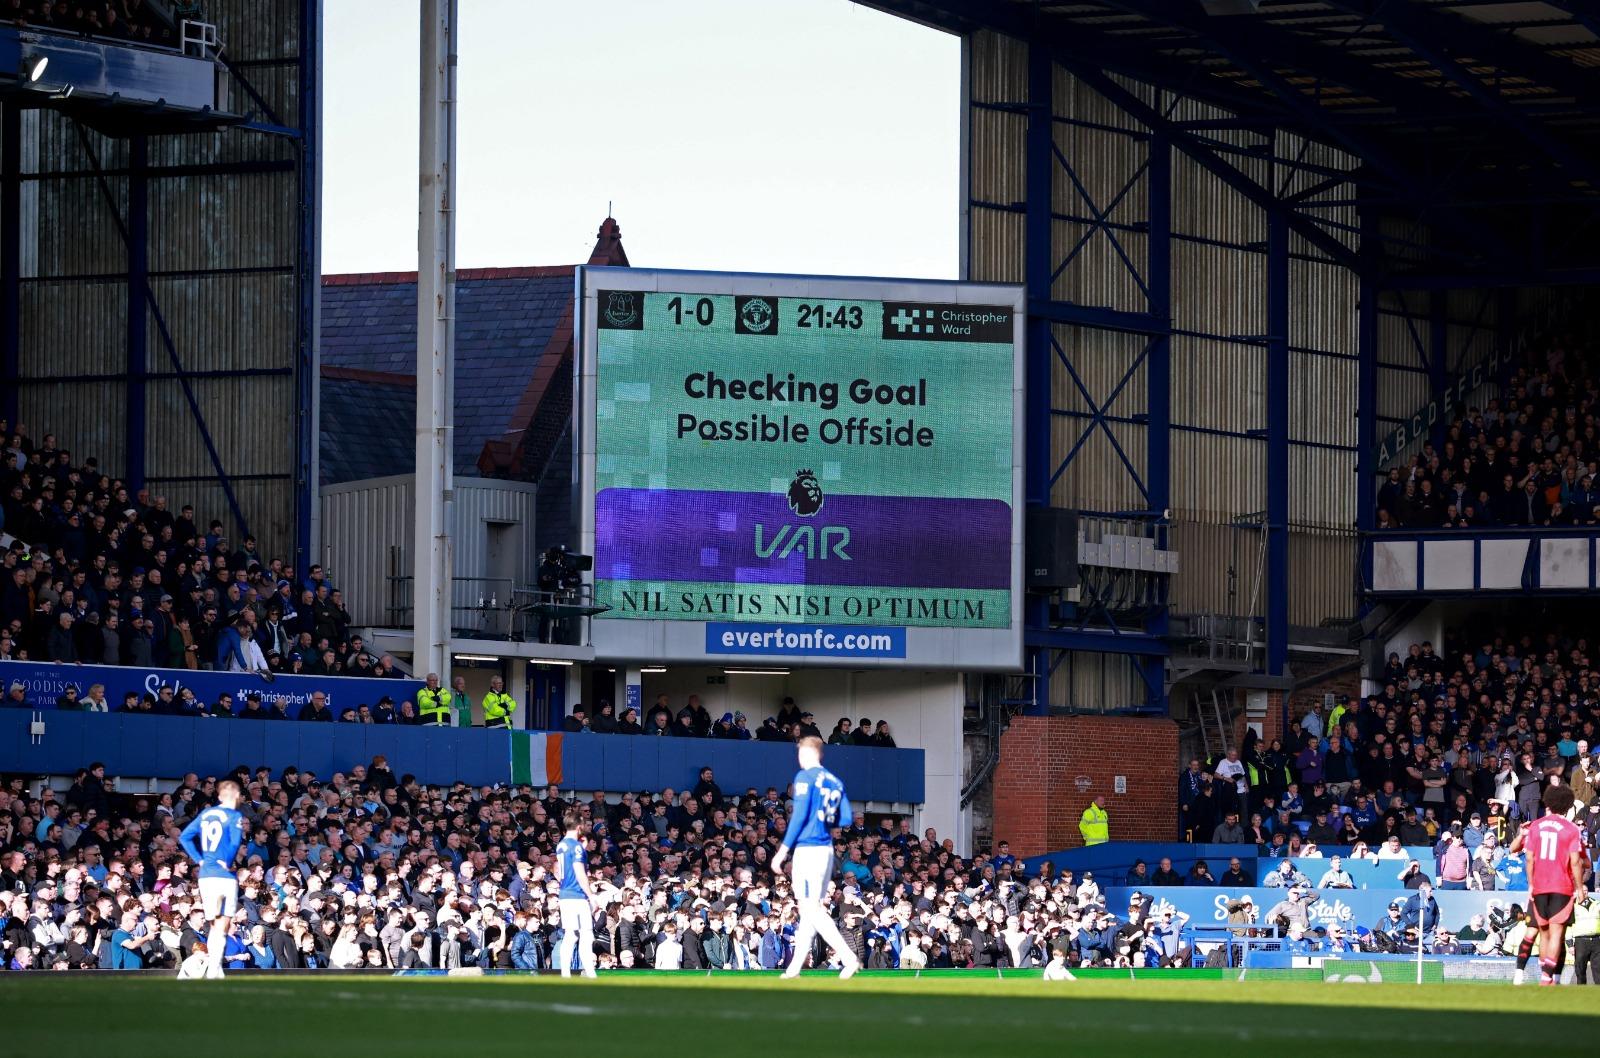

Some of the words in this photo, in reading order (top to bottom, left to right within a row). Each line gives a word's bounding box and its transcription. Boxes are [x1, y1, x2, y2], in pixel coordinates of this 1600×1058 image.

[667, 297, 714, 326] 1-0
[797, 304, 863, 330] 21:43
[941, 310, 1007, 324] Christopher
[941, 323, 971, 335] Ward
[684, 371, 839, 409] Checking
[849, 379, 927, 405] Goal
[677, 413, 810, 443] Possible
[819, 418, 935, 447] Offside
[1379, 442, 1390, 466] A
[1396, 424, 1406, 450] B
[754, 524, 853, 560] VAR
[621, 591, 669, 612] NIL
[681, 592, 763, 615] SATIS
[774, 595, 832, 617] NISI
[843, 597, 986, 620] OPTIMUM
[721, 627, 892, 651] evertonfc.com
[38, 695, 57, 705] PARK
[201, 821, 223, 852] 19
[1540, 830, 1558, 860] 11
[1308, 899, 1352, 921] Stake
